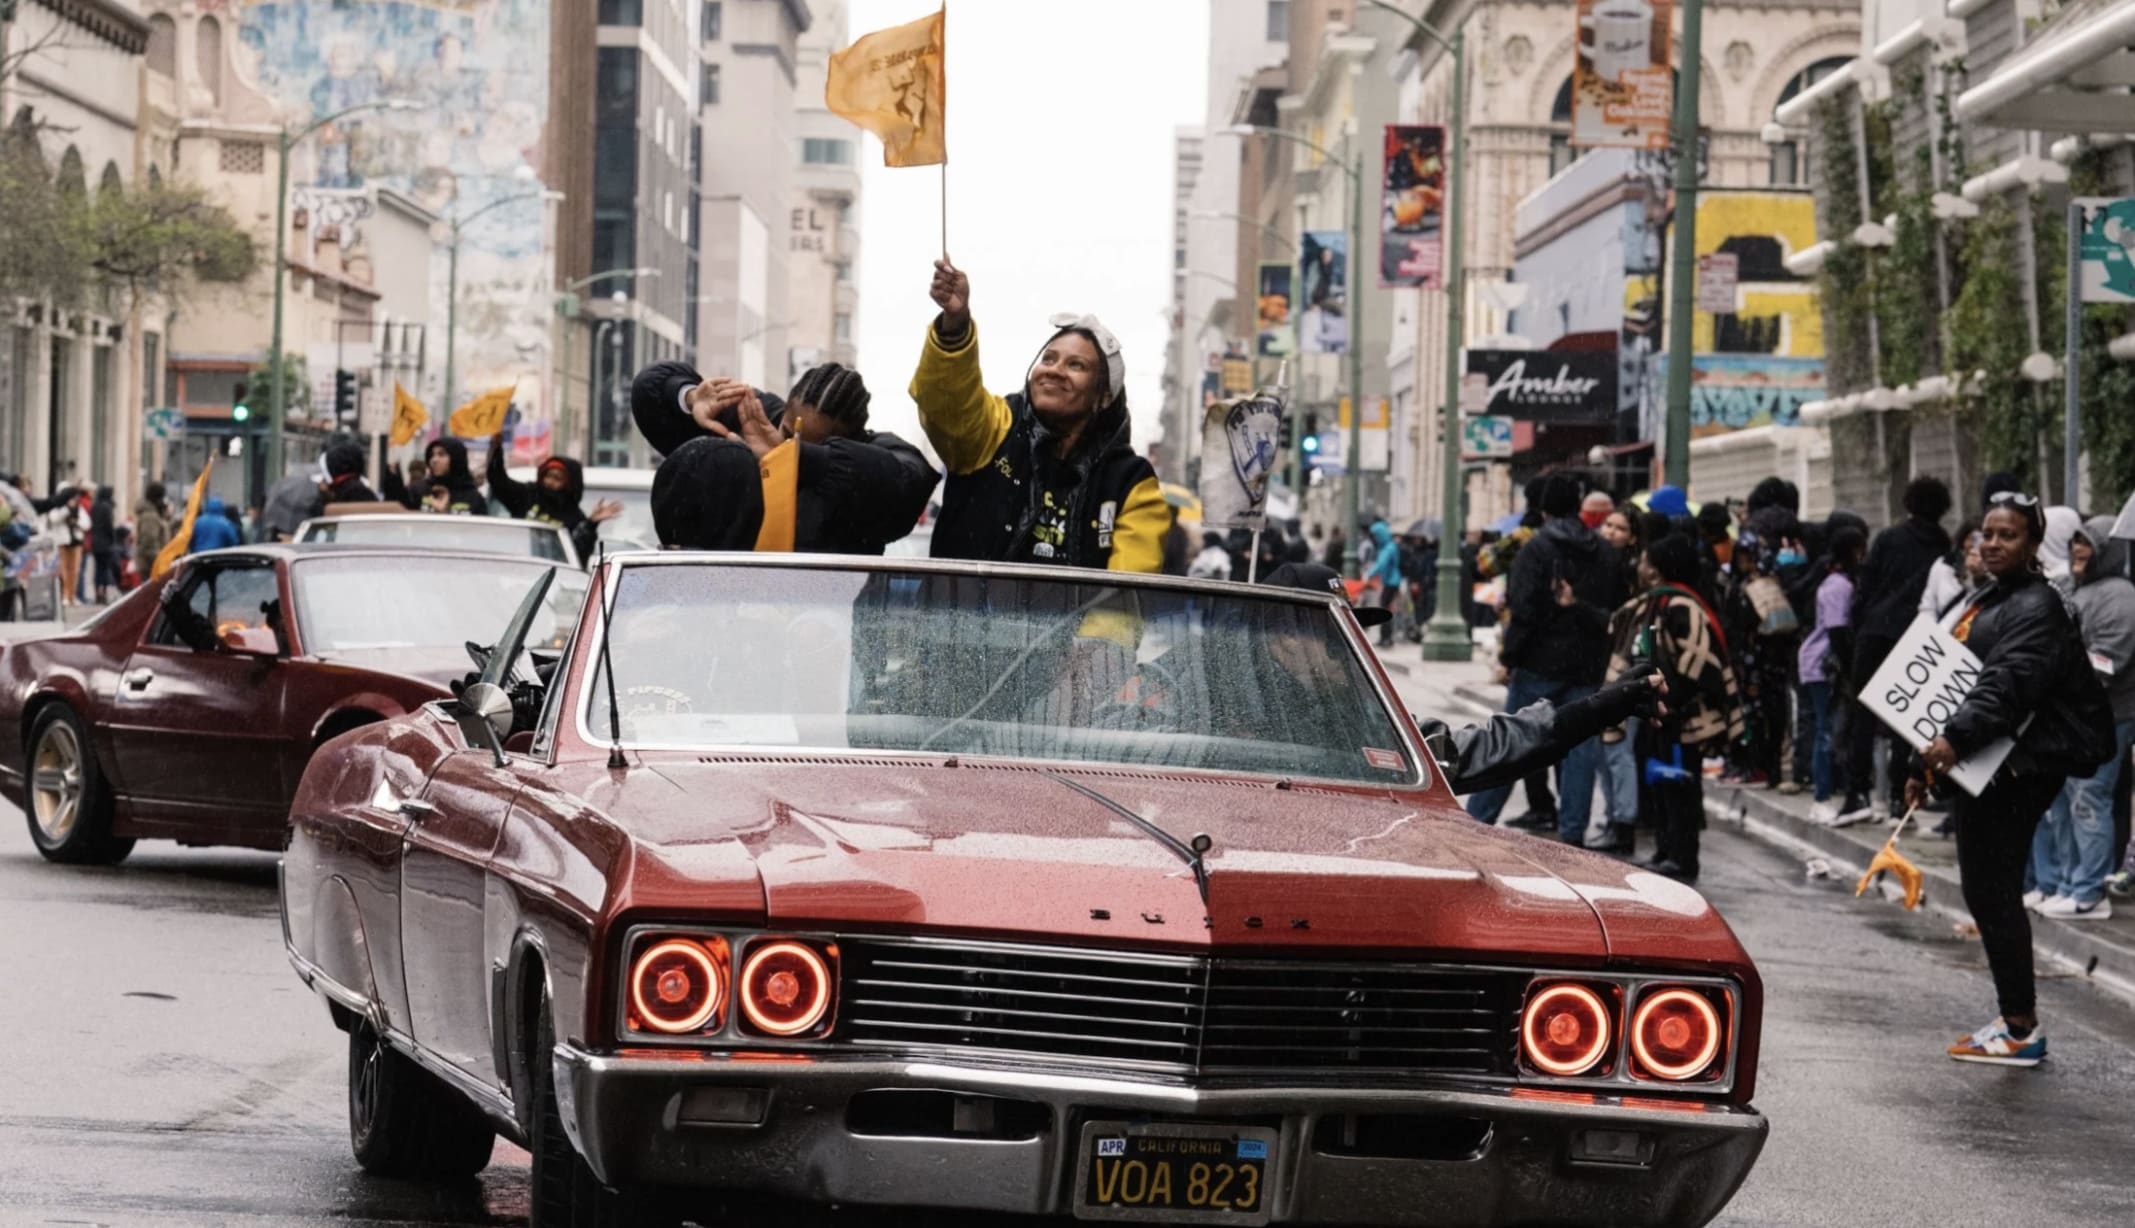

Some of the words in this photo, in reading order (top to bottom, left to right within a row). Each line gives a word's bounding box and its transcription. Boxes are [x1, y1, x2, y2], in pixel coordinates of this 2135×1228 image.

[1487, 359, 1599, 405] Amber
[1517, 395, 1582, 404] LOUNGE
[1885, 635, 1946, 713] SLOW
[1913, 658, 1980, 742] DOWN
[1089, 908, 1311, 930] BUICK
[1101, 1140, 1124, 1153] APR
[1138, 1138, 1222, 1154] CALIFORNIA
[1096, 1158, 1171, 1205] VOA
[1187, 1162, 1259, 1208] 823
